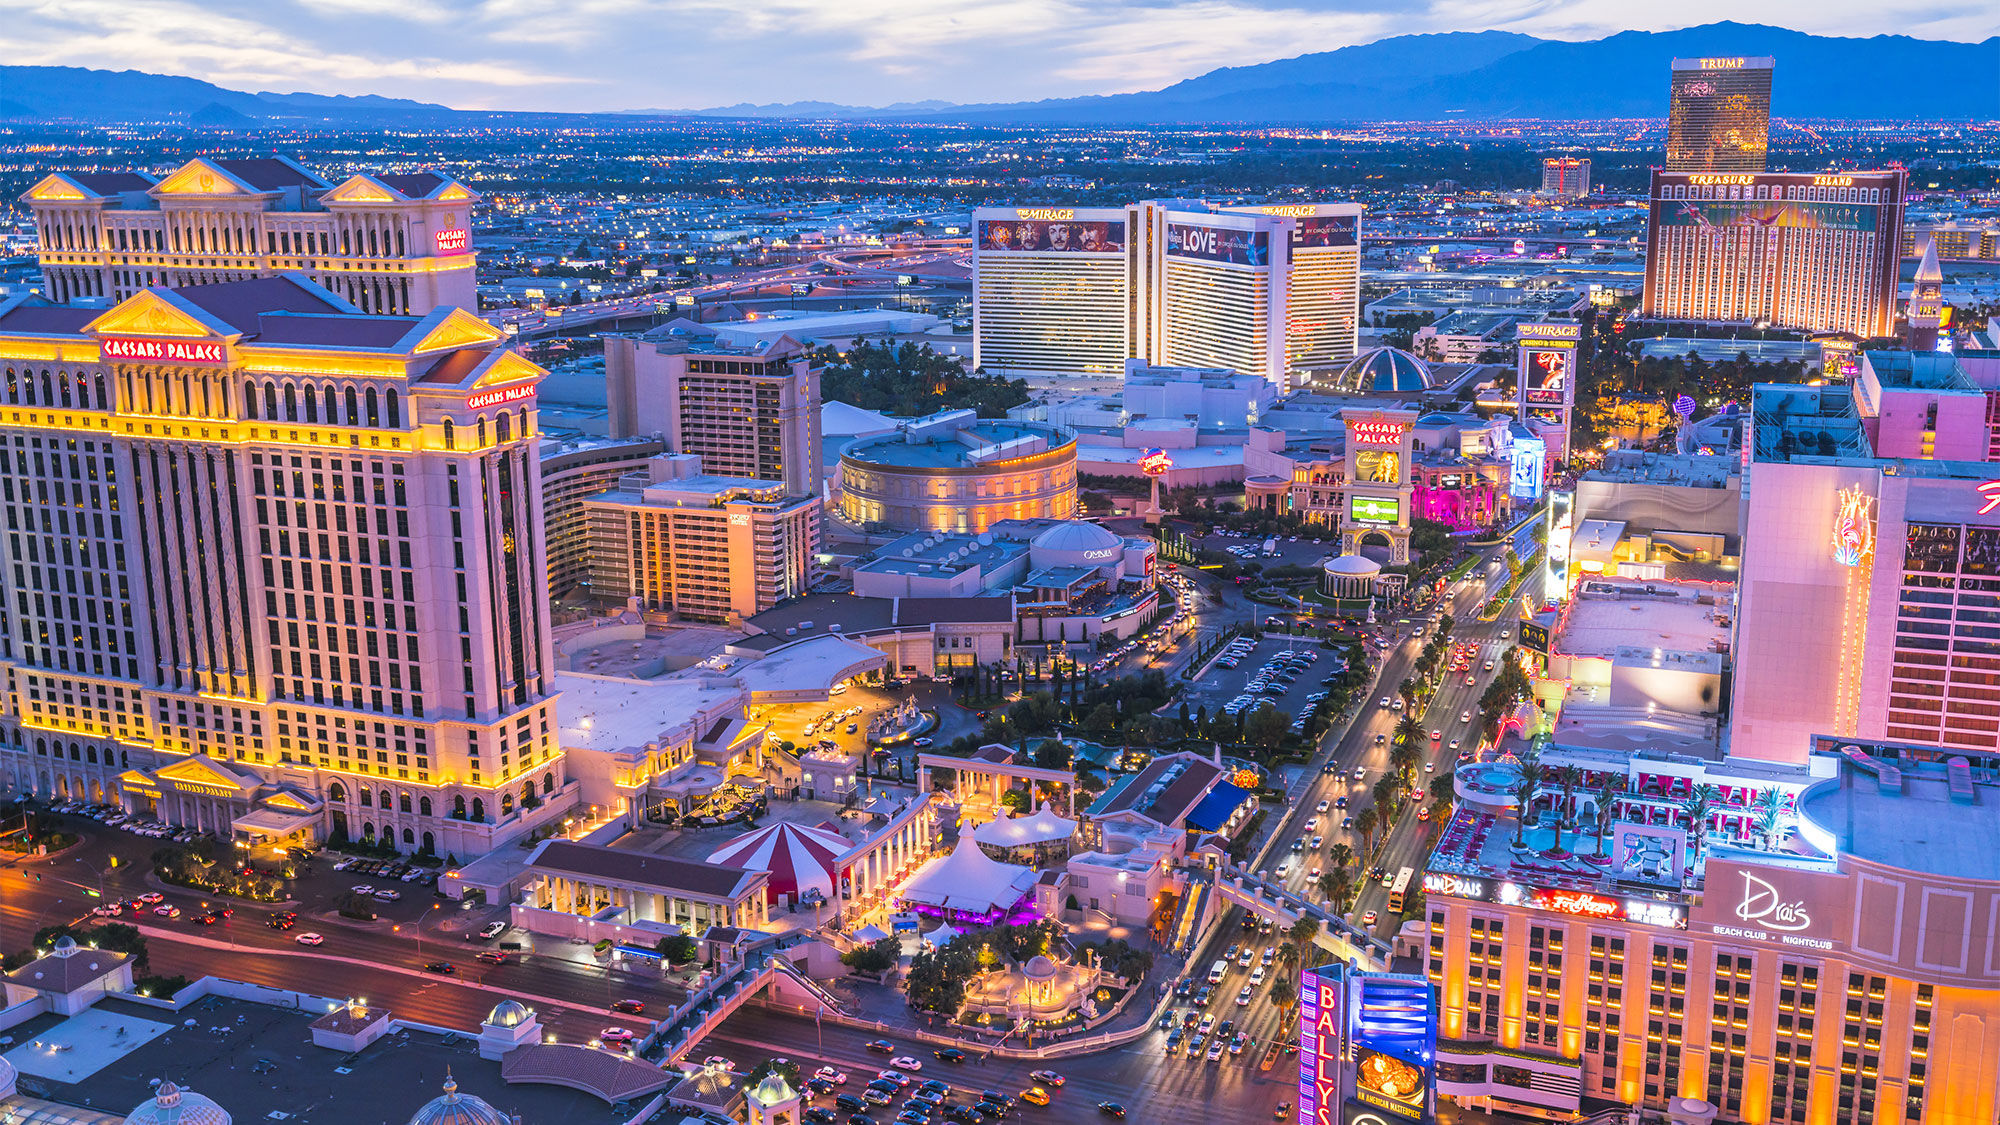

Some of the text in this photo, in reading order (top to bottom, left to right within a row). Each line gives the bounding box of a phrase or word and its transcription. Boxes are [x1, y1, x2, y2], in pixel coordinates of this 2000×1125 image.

[1700, 58, 1745, 69] TRUMP
[1690, 174, 1853, 186] TREASURE ISLAND
[1024, 209, 1074, 220] MIRAGE
[1273, 206, 1316, 217] MIRAGE
[437, 230, 466, 241] CAESARS
[1183, 229, 1217, 254] LOVE
[438, 239, 466, 250] PALACE
[1523, 326, 1578, 337] MIRAGE
[104, 340, 221, 361] CAESARS PALACE
[468, 385, 534, 409] CAESARS PALACE
[1353, 422, 1403, 434] CAESARS
[1355, 432, 1400, 444] PALACE
[1735, 870, 1811, 931] Drai's
[1713, 925, 1833, 950] BEACH CLUB NIGHTCLUB
[1357, 1091, 1421, 1120] AN AMERICAN MASTERPIECE
